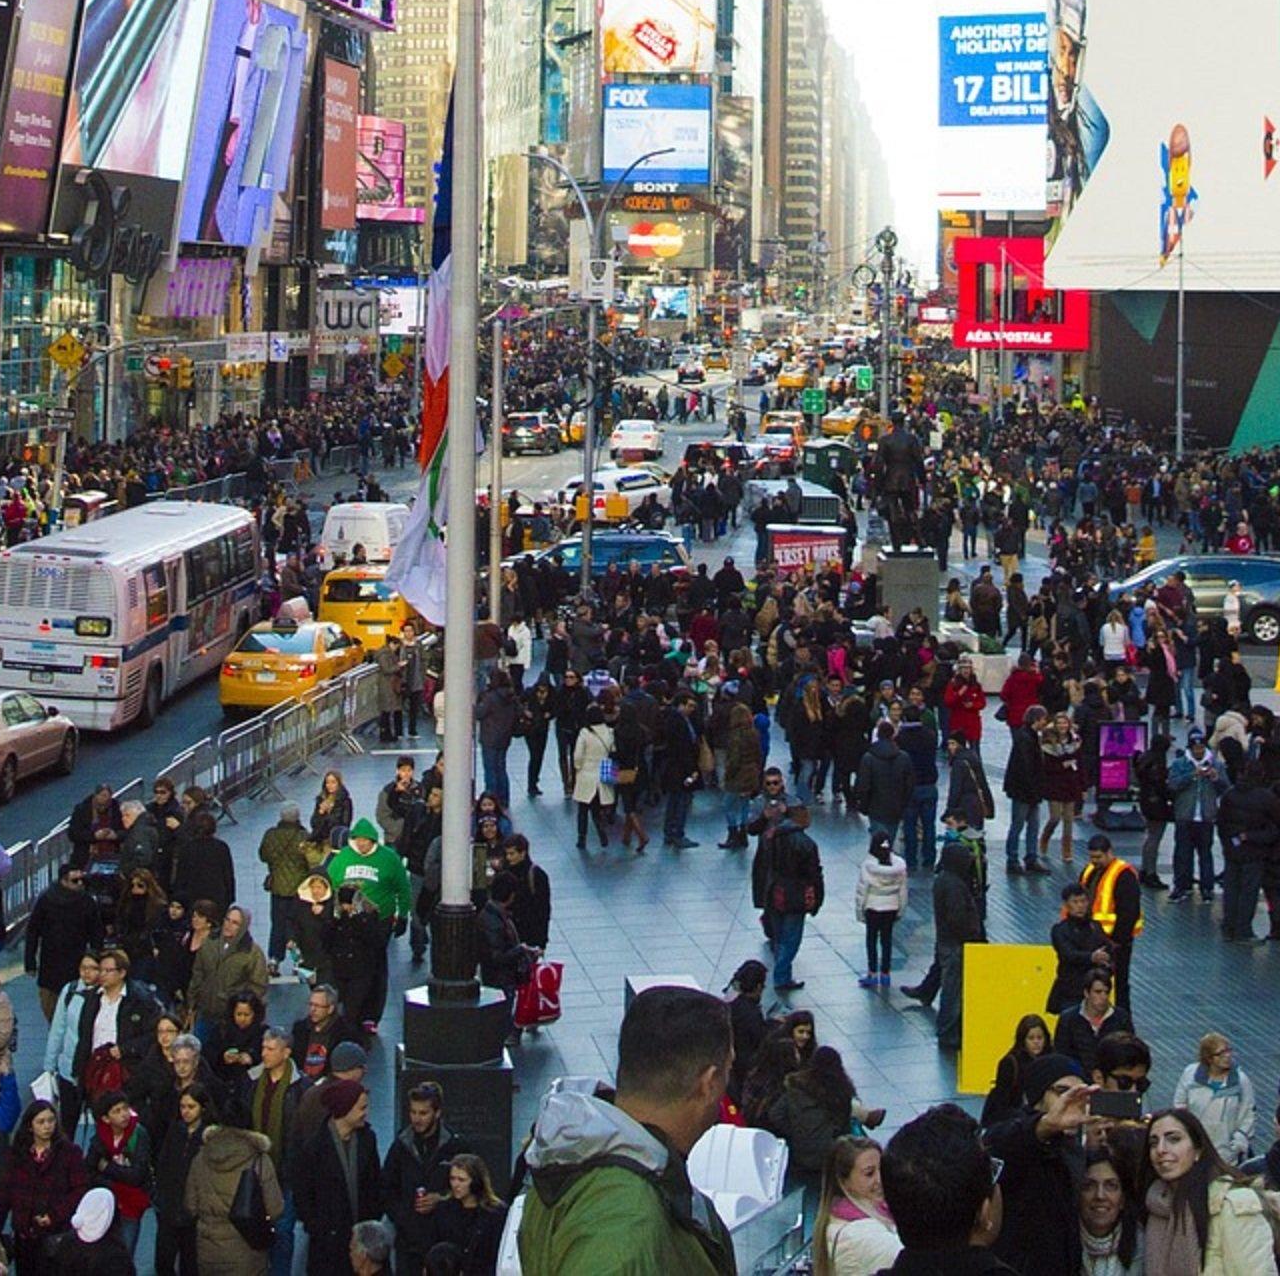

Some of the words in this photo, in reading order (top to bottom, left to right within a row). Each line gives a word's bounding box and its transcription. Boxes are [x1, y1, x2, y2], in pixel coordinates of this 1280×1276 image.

[950, 24, 1021, 42] ANOTHER
[1023, 22, 1048, 38] SU
[956, 39, 1024, 56] HOLIDAY
[609, 88, 649, 109] FOX
[953, 75, 984, 104] 17
[633, 182, 680, 193] SONY
